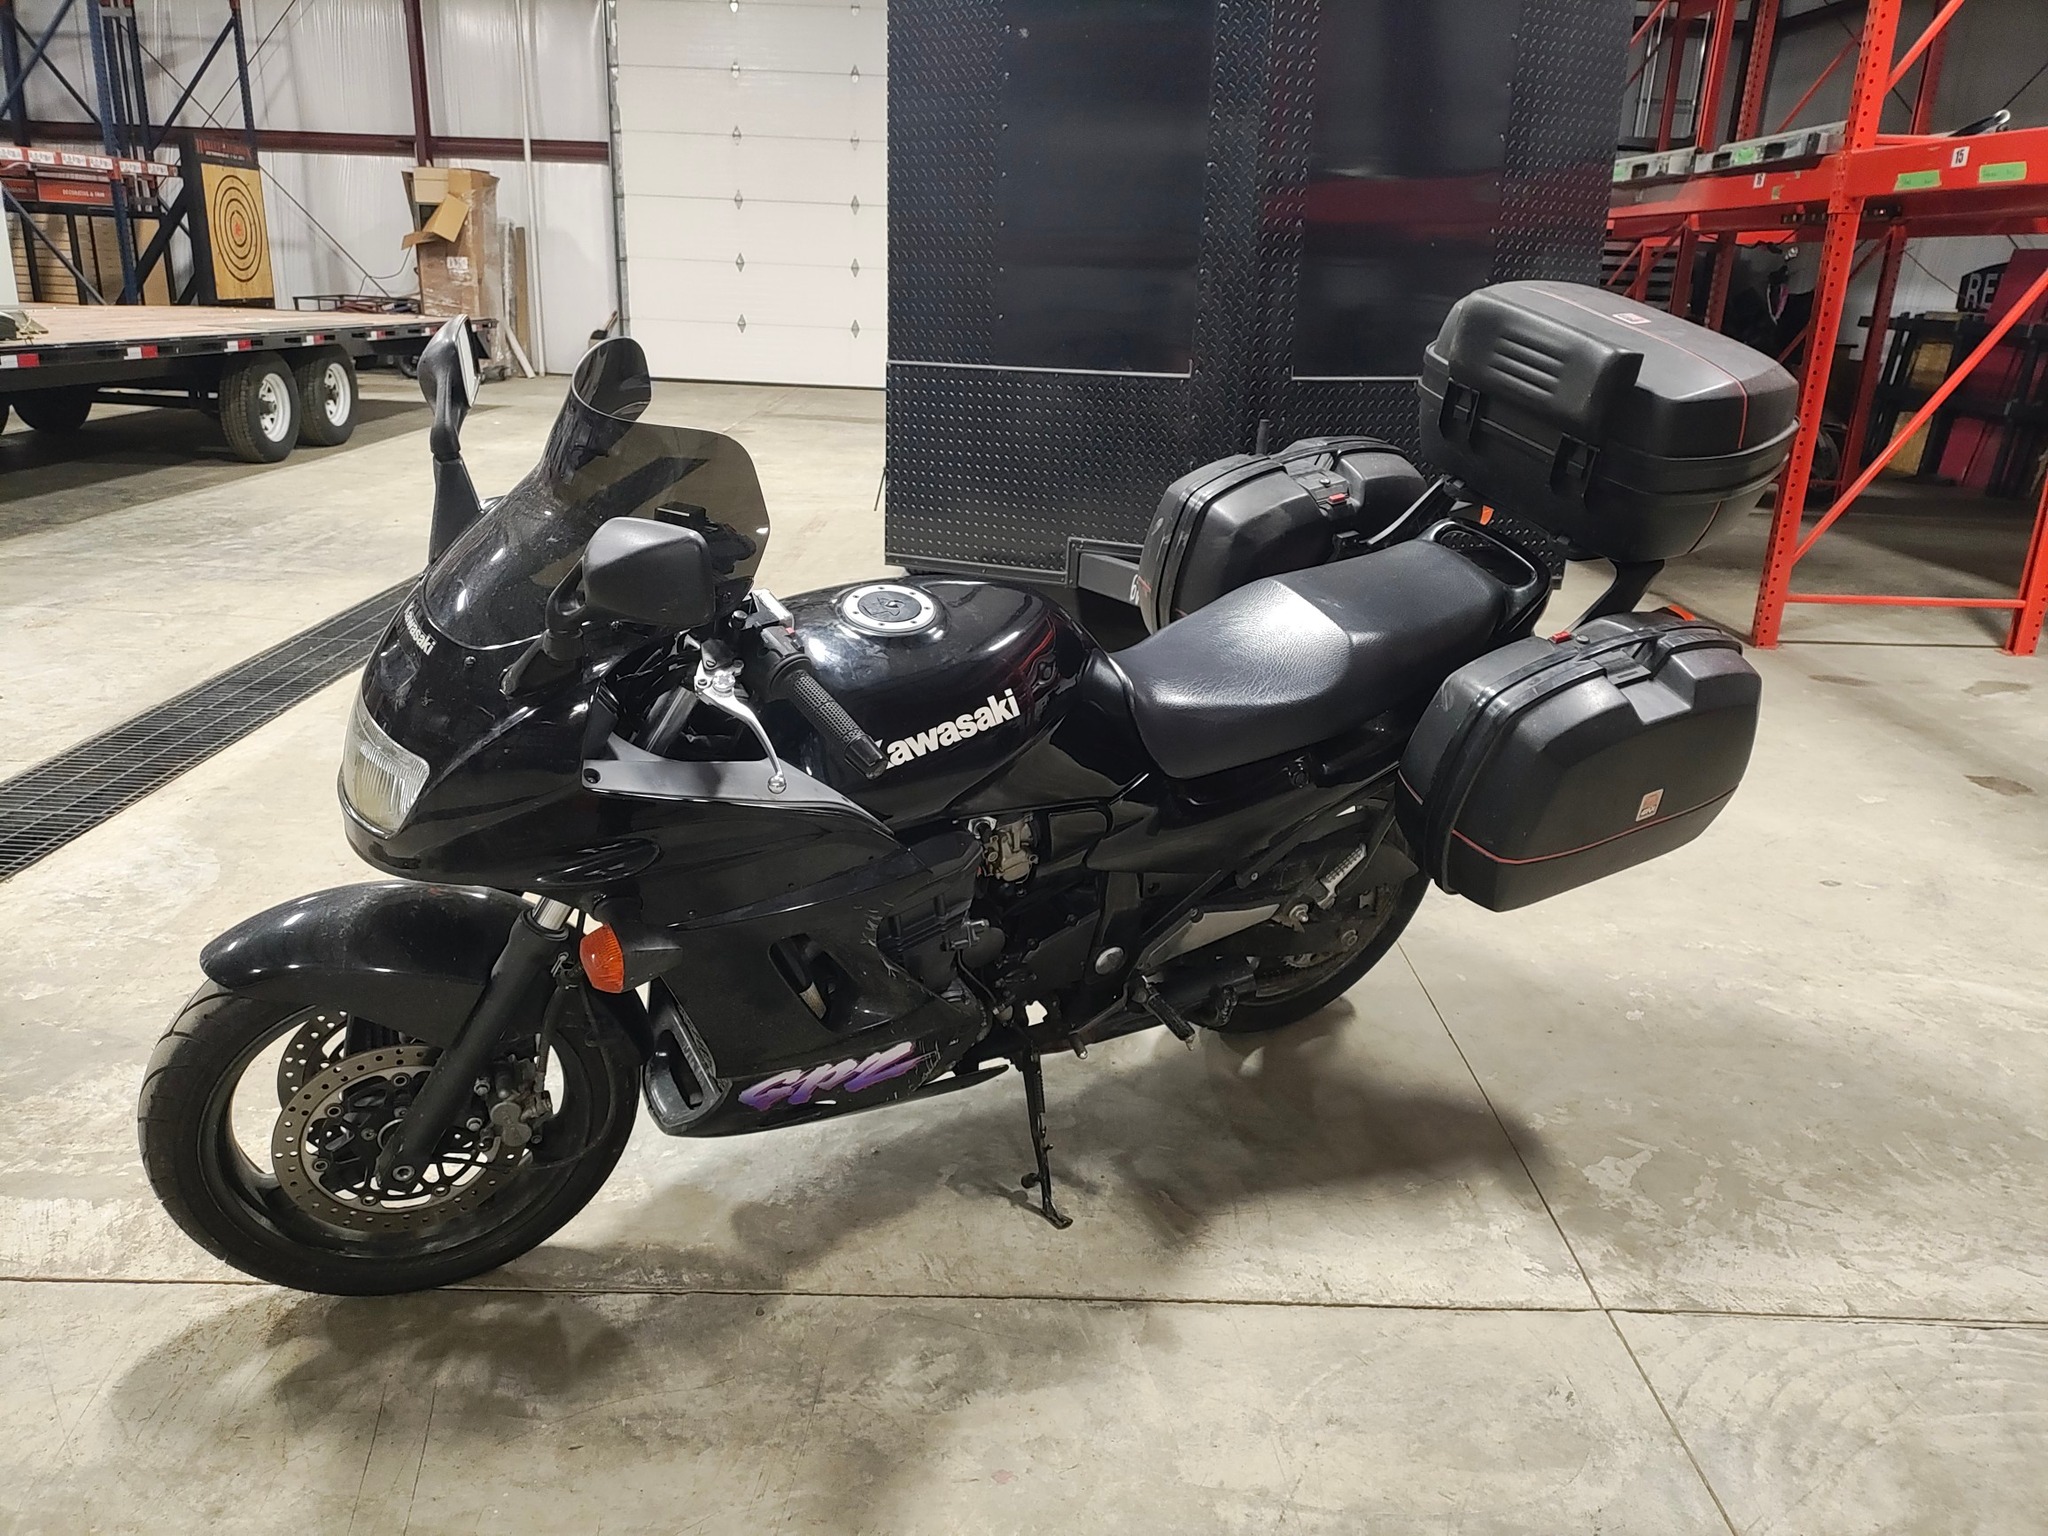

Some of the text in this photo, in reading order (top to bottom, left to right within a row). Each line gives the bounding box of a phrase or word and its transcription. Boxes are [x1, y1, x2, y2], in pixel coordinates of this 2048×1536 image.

[1955, 149, 1965, 165] 15
[1964, 273, 2005, 310] RE
[404, 599, 437, 656] Kawasaki
